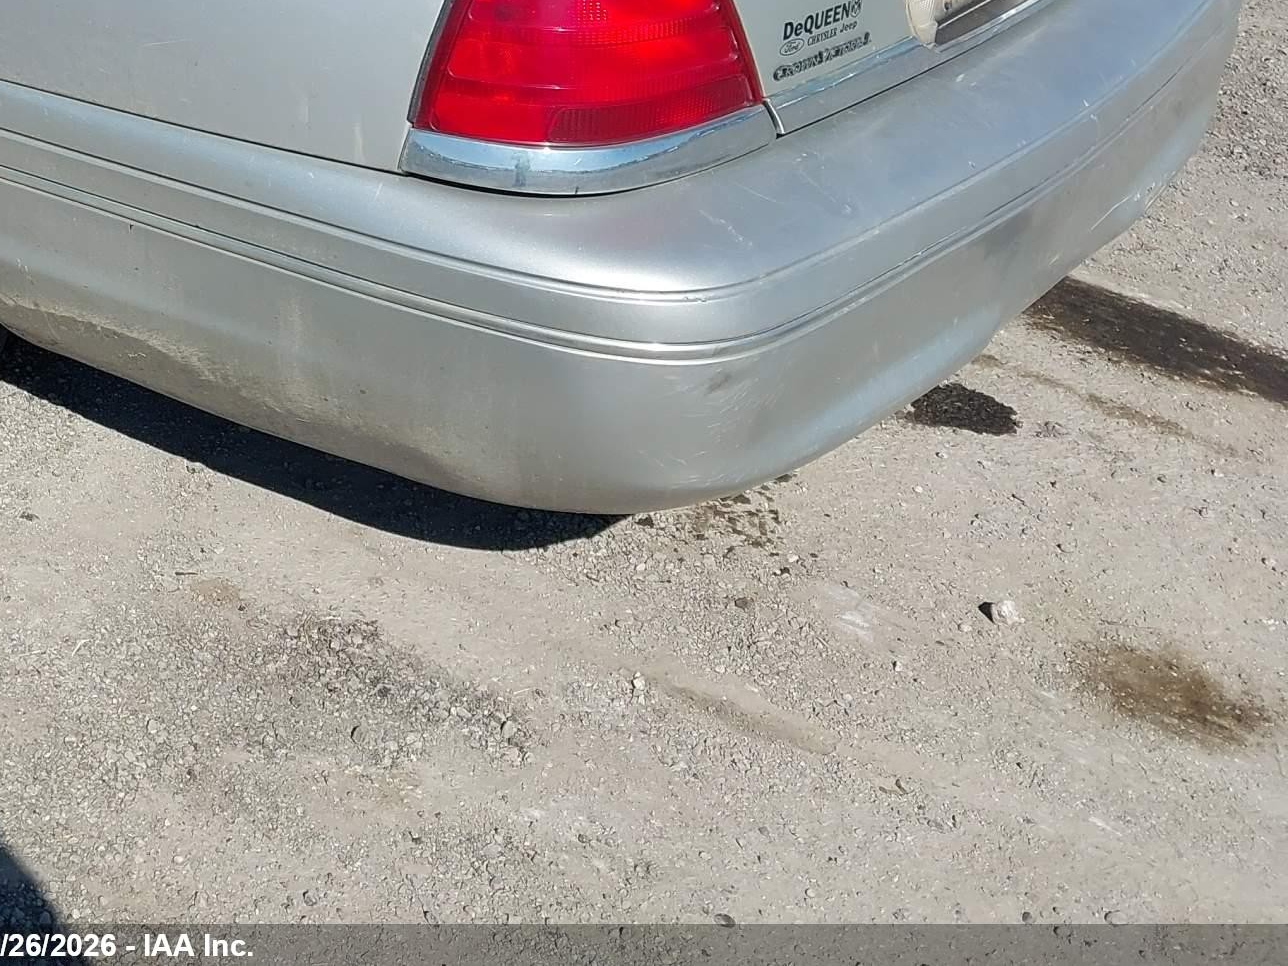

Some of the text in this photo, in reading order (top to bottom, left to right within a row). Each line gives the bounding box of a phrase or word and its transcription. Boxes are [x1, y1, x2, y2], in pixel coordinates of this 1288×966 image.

[783, 0, 852, 41] DeQUEEN
[807, 27, 838, 46] CHRYSLER
[840, 20, 858, 34] Jeep
